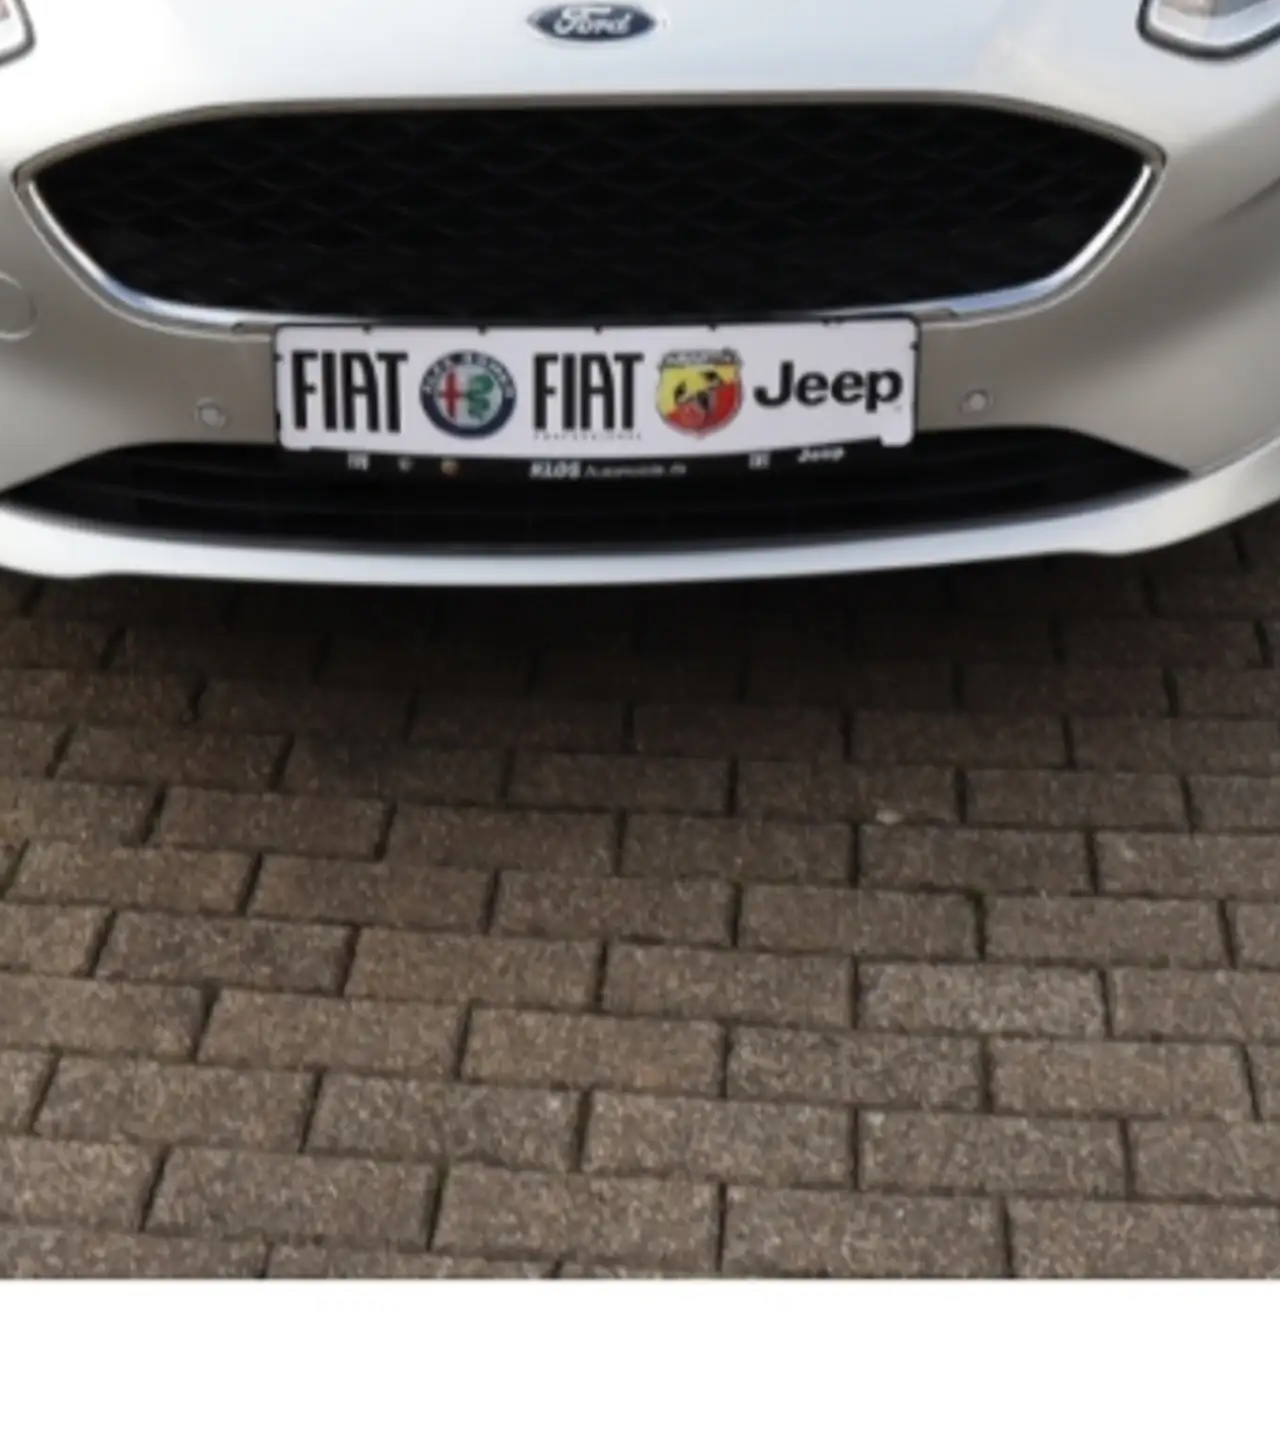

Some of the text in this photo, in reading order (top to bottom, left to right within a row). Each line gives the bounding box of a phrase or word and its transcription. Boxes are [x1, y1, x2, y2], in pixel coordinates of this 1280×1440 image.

[553, 6, 632, 35] Ford
[291, 350, 408, 433] FIAT
[534, 352, 645, 430] FIAT
[753, 359, 904, 413] Jeep
